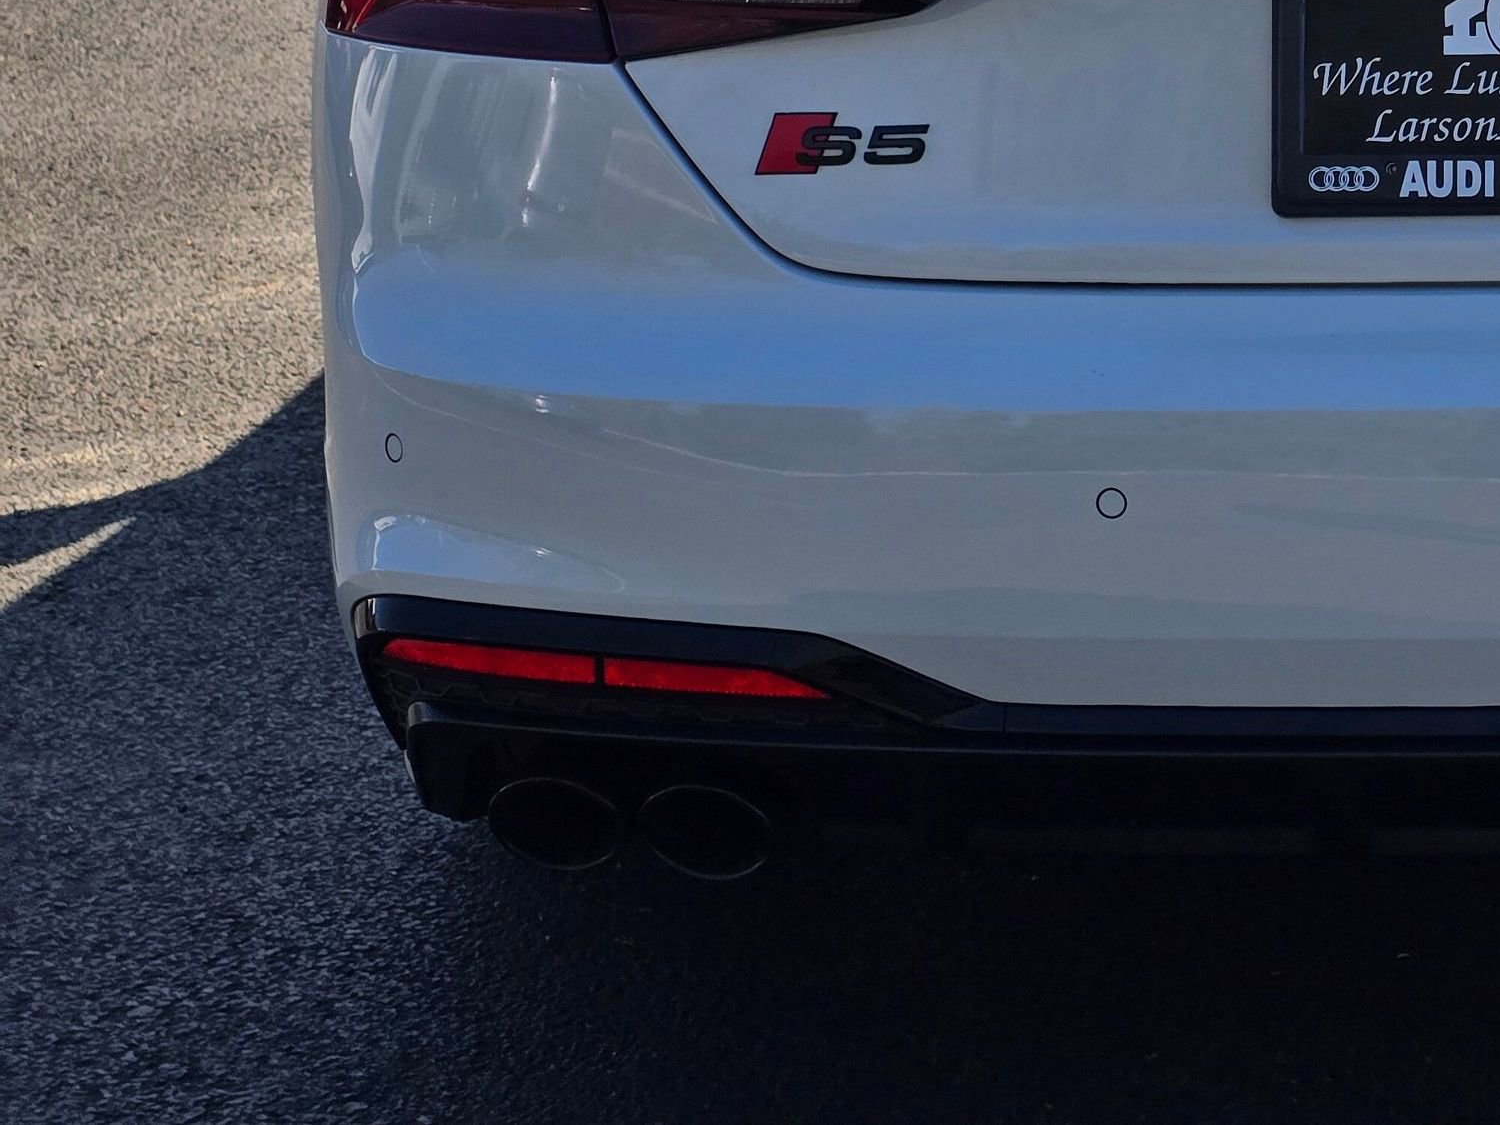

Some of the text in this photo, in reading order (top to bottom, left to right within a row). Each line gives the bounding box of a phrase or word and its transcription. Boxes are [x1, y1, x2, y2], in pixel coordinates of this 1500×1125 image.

[1313, 56, 1434, 96] Where
[795, 124, 930, 166] S5
[1399, 159, 1495, 198] AUDI
